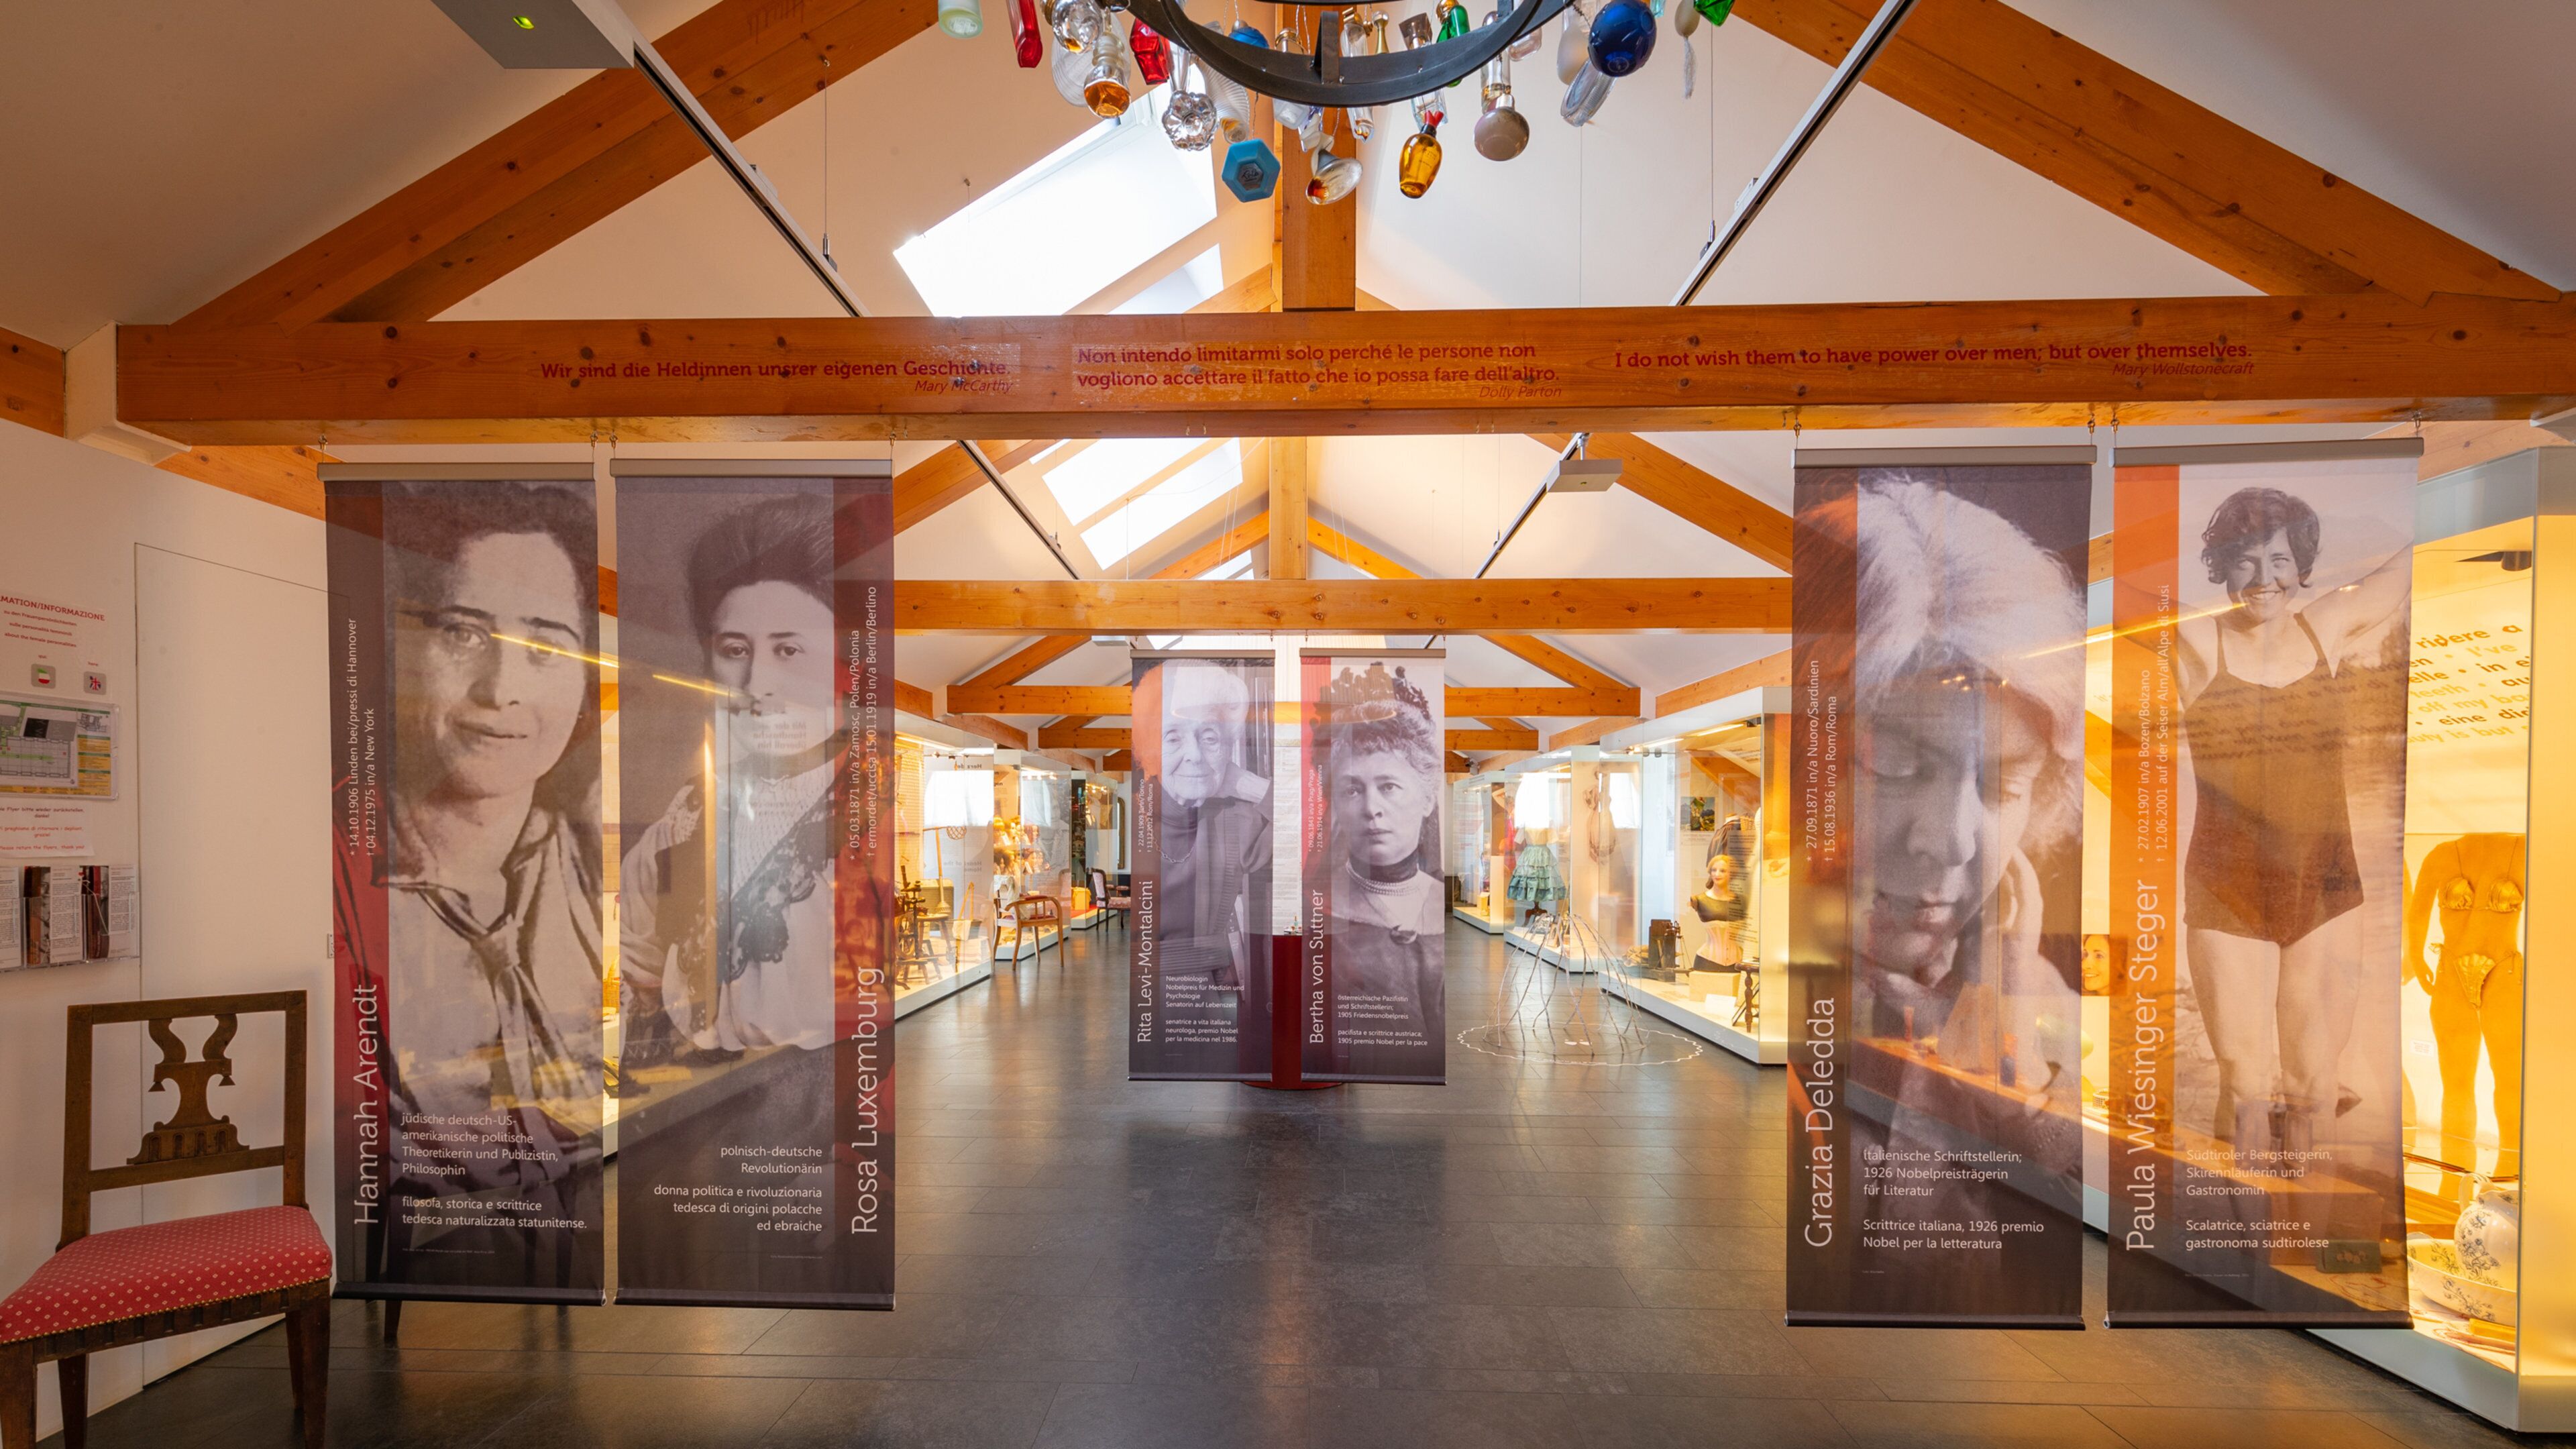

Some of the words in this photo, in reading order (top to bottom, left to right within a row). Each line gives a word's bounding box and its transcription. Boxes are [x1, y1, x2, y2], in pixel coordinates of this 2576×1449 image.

[1078, 348, 1116, 363] Non
[1121, 347, 1191, 362] intendo
[1197, 346, 1281, 362] limitarmi
[1286, 345, 1324, 361] solo
[1329, 344, 1392, 362] perché
[1397, 344, 1413, 359] le
[1419, 345, 1493, 362] persone
[1499, 345, 1536, 358] non
[1615, 353, 1621, 367] I
[1627, 352, 1652, 367] do
[1657, 354, 1690, 366] not
[1695, 350, 1739, 366] wish
[1745, 350, 1796, 365] them
[1801, 351, 1821, 364] to
[1826, 348, 1872, 363] have
[1878, 349, 1939, 364] power
[1945, 348, 1988, 361] over
[1993, 347, 2041, 362] men;
[2049, 344, 2082, 360] but
[2087, 346, 2131, 358] over
[2137, 342, 2252, 358] themselves.
[541, 363, 572, 378] Wir
[579, 363, 616, 378] sind
[623, 363, 650, 377] die
[657, 362, 752, 376] Heldinnen
[758, 364, 817, 376] unsrer
[823, 361, 896, 380] eigenen
[903, 360, 1010, 376] Geschichte.
[1077, 371, 1157, 390] vogliono
[1163, 371, 1246, 386] accettare
[1252, 370, 1263, 384] il
[1268, 368, 1310, 384] fatto
[1316, 368, 1348, 384] che
[1354, 368, 1371, 383] io
[1377, 370, 1429, 386] possa
[1434, 367, 1469, 382] fare
[1474, 366, 1560, 382] dell'altro.
[2112, 363, 2148, 378] Mary
[2153, 361, 2254, 374] Wollstonecraft
[914, 380, 948, 394] Mary
[951, 379, 1013, 394] McCarthy
[1479, 386, 1513, 400] Dolly
[1517, 386, 1562, 397] Parton
[347, 618, 357, 672] Hannover
[2416, 631, 2490, 648] ridere
[2502, 625, 2523, 633] a
[2475, 663, 2508, 672] in
[347, 676, 358, 686] di
[1807, 660, 1819, 757] Nuoro/Sardinien
[2139, 670, 2151, 757] Bozen/Bolzano
[2453, 700, 2488, 708] my
[347, 690, 360, 744] bei/pressi
[364, 708, 374, 733] York
[1825, 696, 1837, 761] Rom/Roma
[2438, 715, 2487, 724] eine
[364, 737, 375, 760] New
[347, 747, 359, 784] Linden
[365, 764, 376, 786] in/a
[1807, 760, 1819, 783] in/a
[1825, 765, 1837, 787] in/a
[2139, 761, 2150, 784] in/a
[349, 788, 359, 847] 14.10.1906
[365, 789, 376, 849] 04.12.1975
[1806, 787, 1819, 849] 27.09.1871
[1825, 791, 1836, 853] 15.08.1936
[2138, 788, 2149, 850] 27.02.1907
[1309, 890, 1324, 949] Suttner
[2129, 879, 2165, 981] Steger
[1138, 881, 1152, 1007] Levi-Montalcini
[1166, 975, 1208, 983] Neurobiologin
[1312, 954, 1324, 985] von
[1137, 1012, 1152, 1042] Rita
[1309, 991, 1324, 1043] Bertha
[1354, 1012, 1409, 1020] Friedensnobelpreis
[352, 984, 377, 1091] Arendt
[851, 967, 885, 1148] Luxemburg
[1805, 998, 1834, 1132] Deledda
[2127, 992, 2164, 1155] Wiesinger
[400, 1113, 444, 1126] jüdische
[447, 1114, 517, 1126] deutsch-US-
[402, 1130, 478, 1142] amerikanische
[482, 1131, 533, 1144] politische
[354, 1100, 378, 1224] Hannah
[720, 1146, 822, 1158] polnisch-deutsche
[1864, 1150, 1931, 1162] italienische
[1933, 1150, 2022, 1163] Schriftstellerin;
[2187, 1148, 2246, 1161] Südtiroler
[2249, 1148, 2333, 1163] Bergsteigerin,
[741, 1163, 822, 1174] Revolutionärin
[1864, 1167, 1892, 1178] 1926
[1896, 1168, 2008, 1182] Nobelpreisträgerin
[2186, 1167, 2277, 1178] Skirennläuferin
[2281, 1167, 2305, 1178] und
[654, 1185, 689, 1196] donna
[692, 1185, 733, 1198] politica
[737, 1189, 743, 1197] e
[747, 1186, 822, 1197] rivoluzionaria
[851, 1159, 877, 1234] Rosa
[1804, 1144, 1833, 1247] Grazia
[1864, 1185, 1880, 1195] für
[1884, 1185, 1934, 1196] Literatur
[2186, 1184, 2265, 1195] Gastronomin
[402, 1196, 443, 1210] filosofa,
[446, 1198, 482, 1210] storica
[486, 1201, 494, 1210] e
[496, 1199, 542, 1211] scrittrice
[673, 1202, 716, 1213] tedesca
[719, 1202, 730, 1213] di
[733, 1203, 769, 1216] origini
[772, 1203, 822, 1216] polacche
[2126, 1163, 2156, 1250] Paula
[402, 1214, 443, 1224] tedesca
[445, 1215, 515, 1227] naturalizzata
[518, 1217, 588, 1229] statunitense.
[757, 1220, 771, 1231] ed
[774, 1220, 822, 1232] ebraiche
[1863, 1220, 1915, 1231] Scrittrice
[1919, 1220, 1965, 1232] italiana,
[1969, 1221, 1998, 1232] 1926
[2001, 1221, 2044, 1234] premio
[2186, 1220, 2247, 1232] Scalatrice,
[2249, 1220, 2300, 1230] sciatrice
[2302, 1222, 2310, 1231] e
[2186, 1238, 2259, 1250] gastronoma
[2262, 1237, 2329, 1248] sudtirolese
